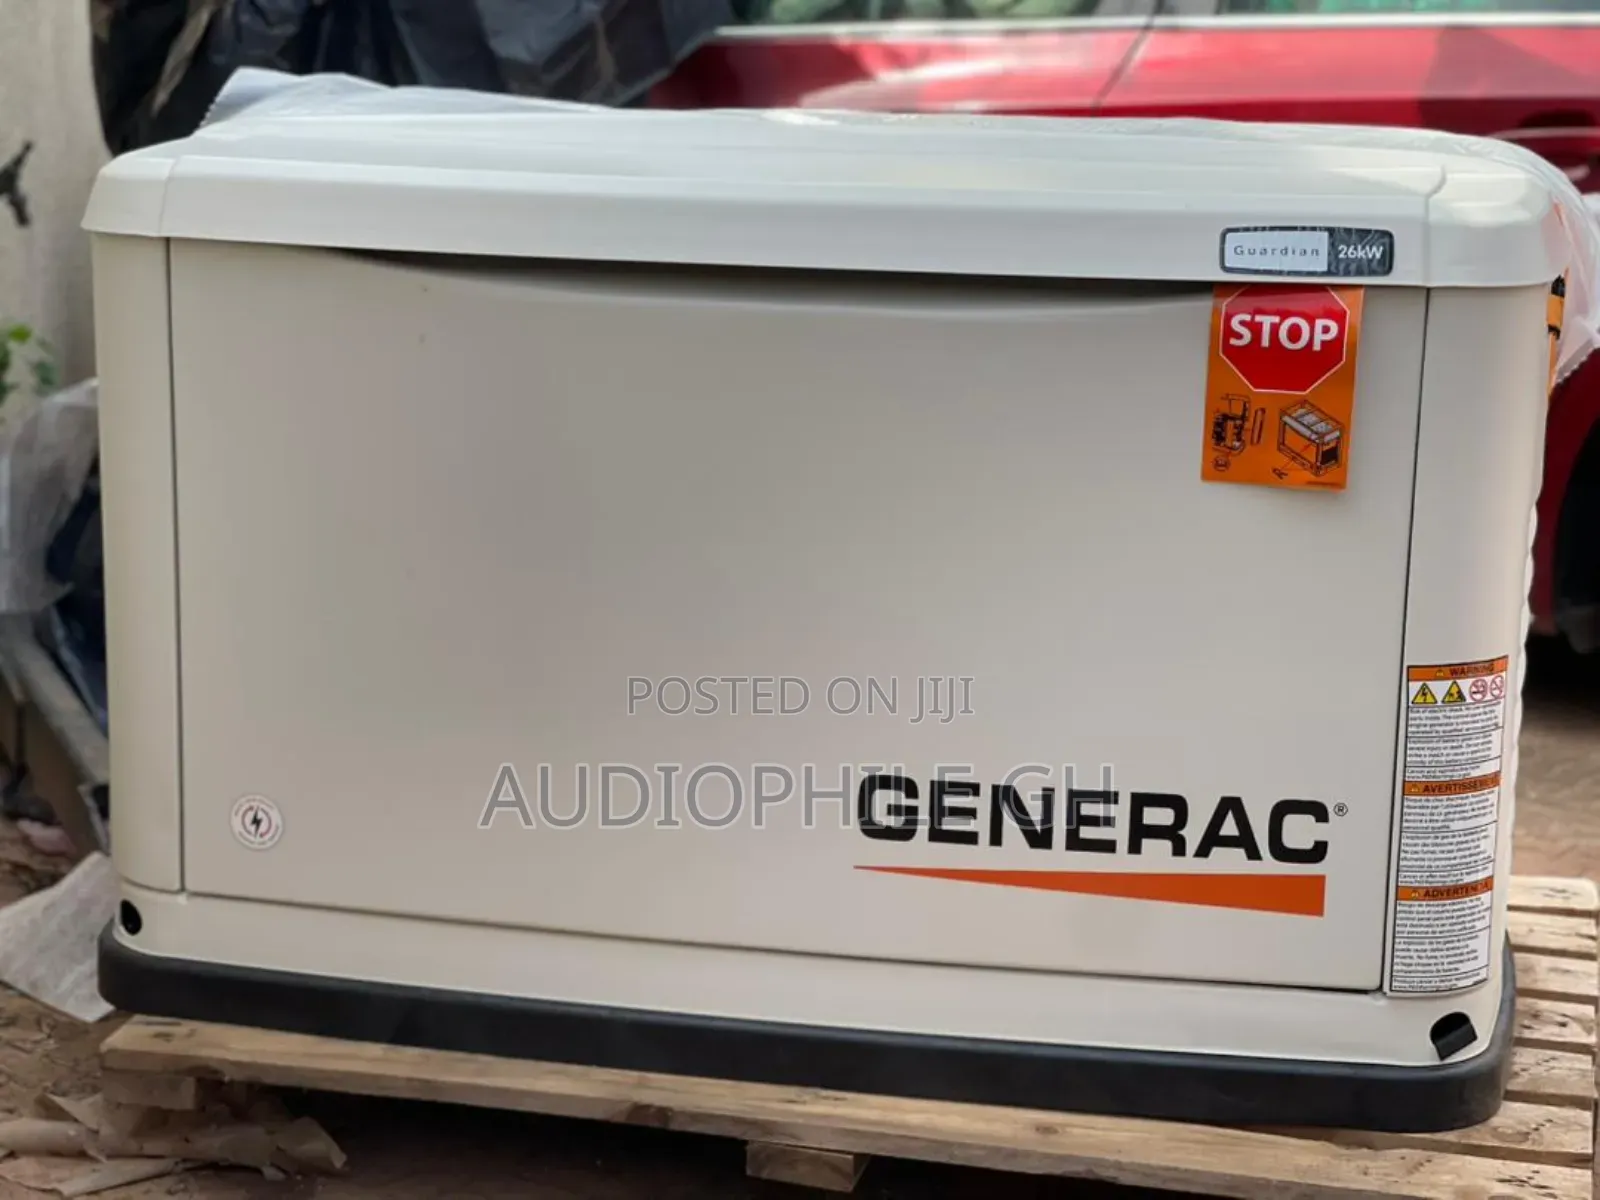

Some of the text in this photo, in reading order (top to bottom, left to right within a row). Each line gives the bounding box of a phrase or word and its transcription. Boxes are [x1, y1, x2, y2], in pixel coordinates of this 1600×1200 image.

[1233, 244, 1383, 260] Guardian 26kW
[1229, 313, 1339, 352] STOP
[1450, 662, 1494, 677] WARNING
